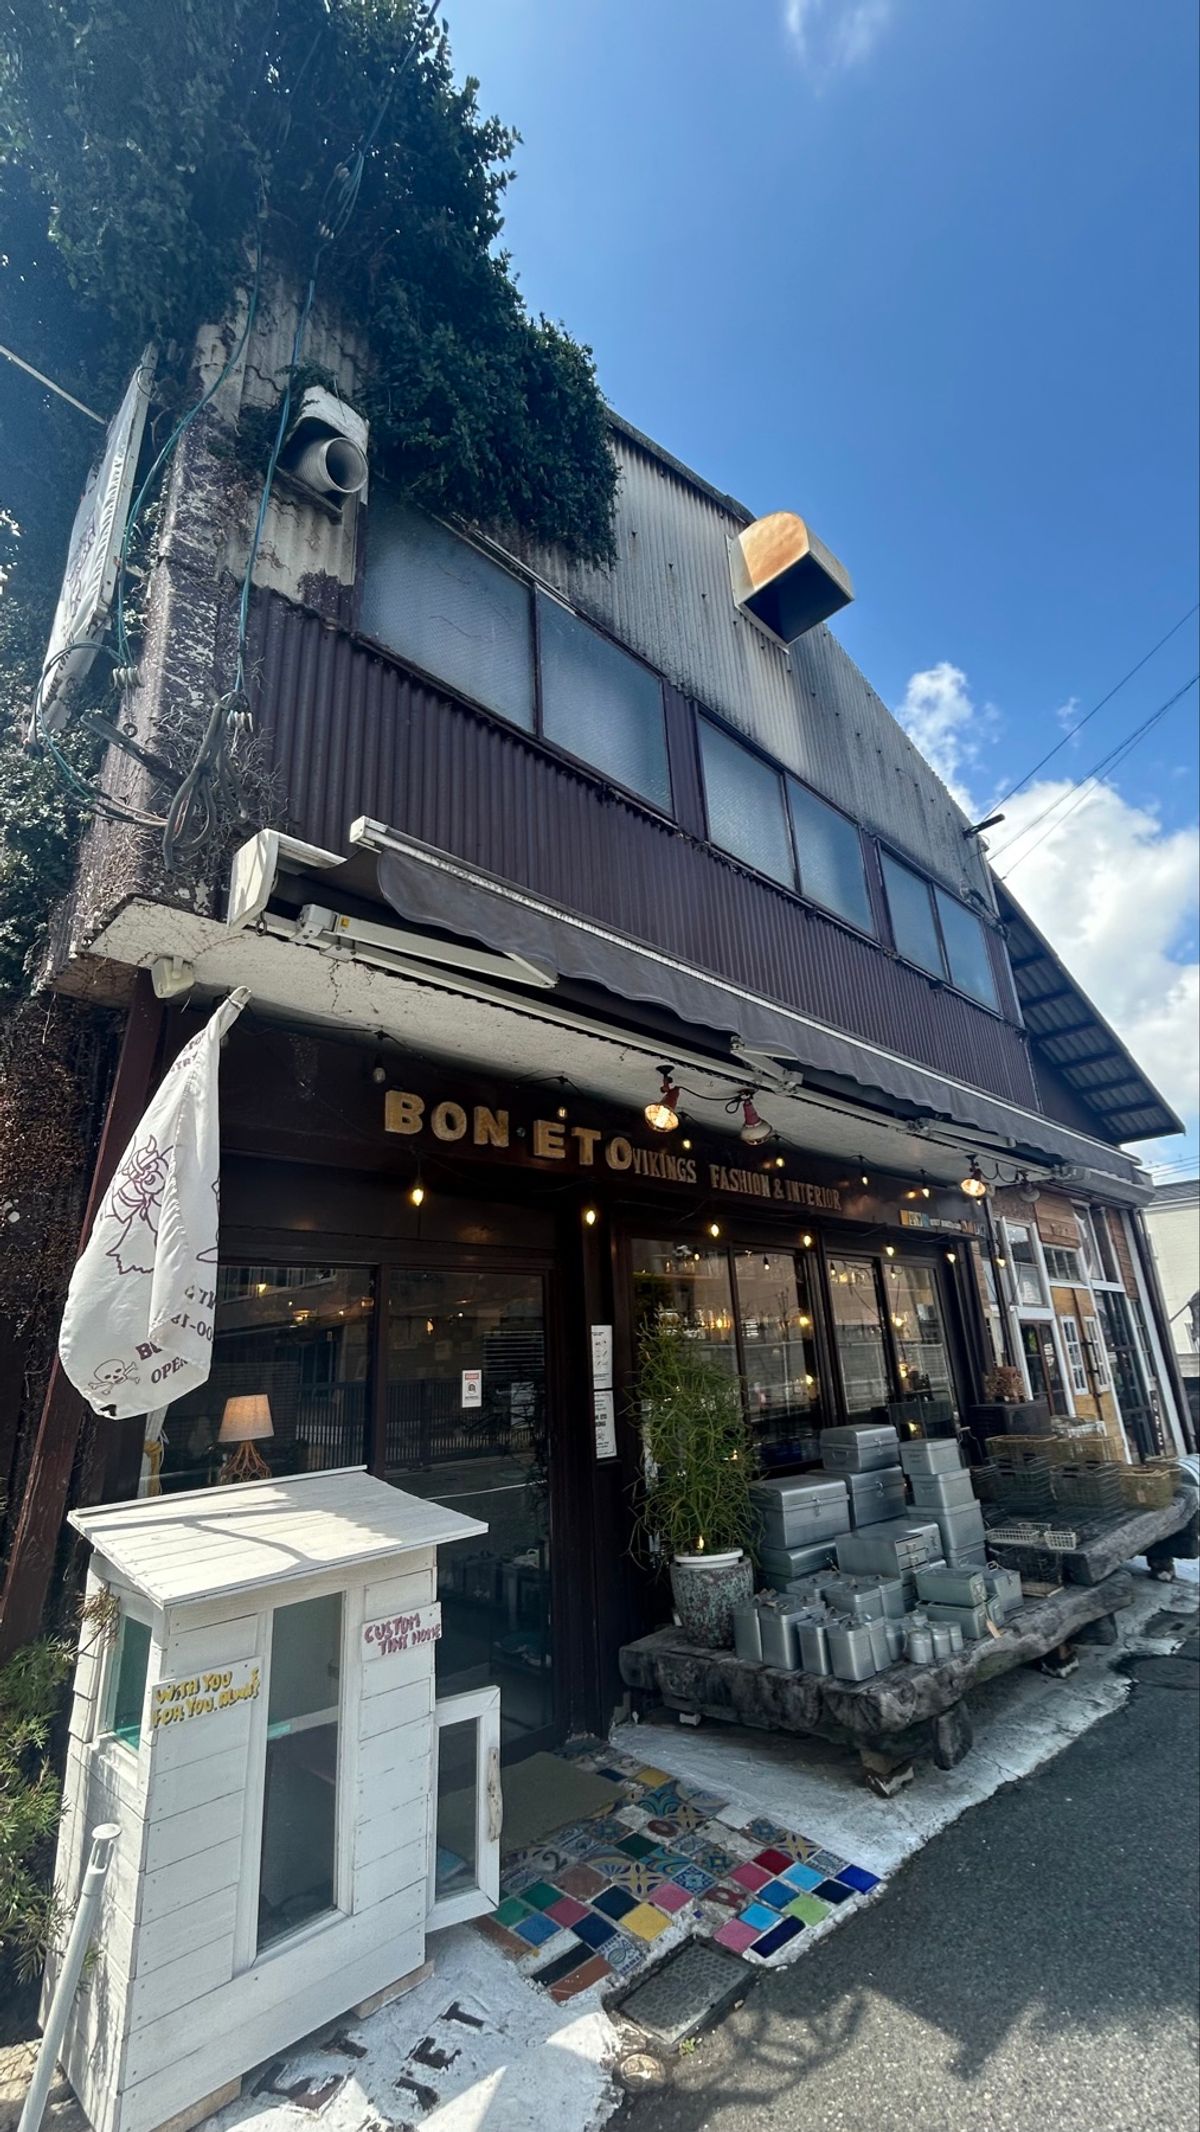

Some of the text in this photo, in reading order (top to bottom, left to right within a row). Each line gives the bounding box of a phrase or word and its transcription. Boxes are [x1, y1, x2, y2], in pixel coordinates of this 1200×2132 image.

[384, 1089, 634, 1171] BON ETO
[632, 1147, 843, 1212] VIKINGS FASHION & INTERIOR
[364, 1612, 422, 1644] CUSTOM
[156, 1671, 233, 1705] WITH YOU
[152, 1703, 185, 1729] FOR
